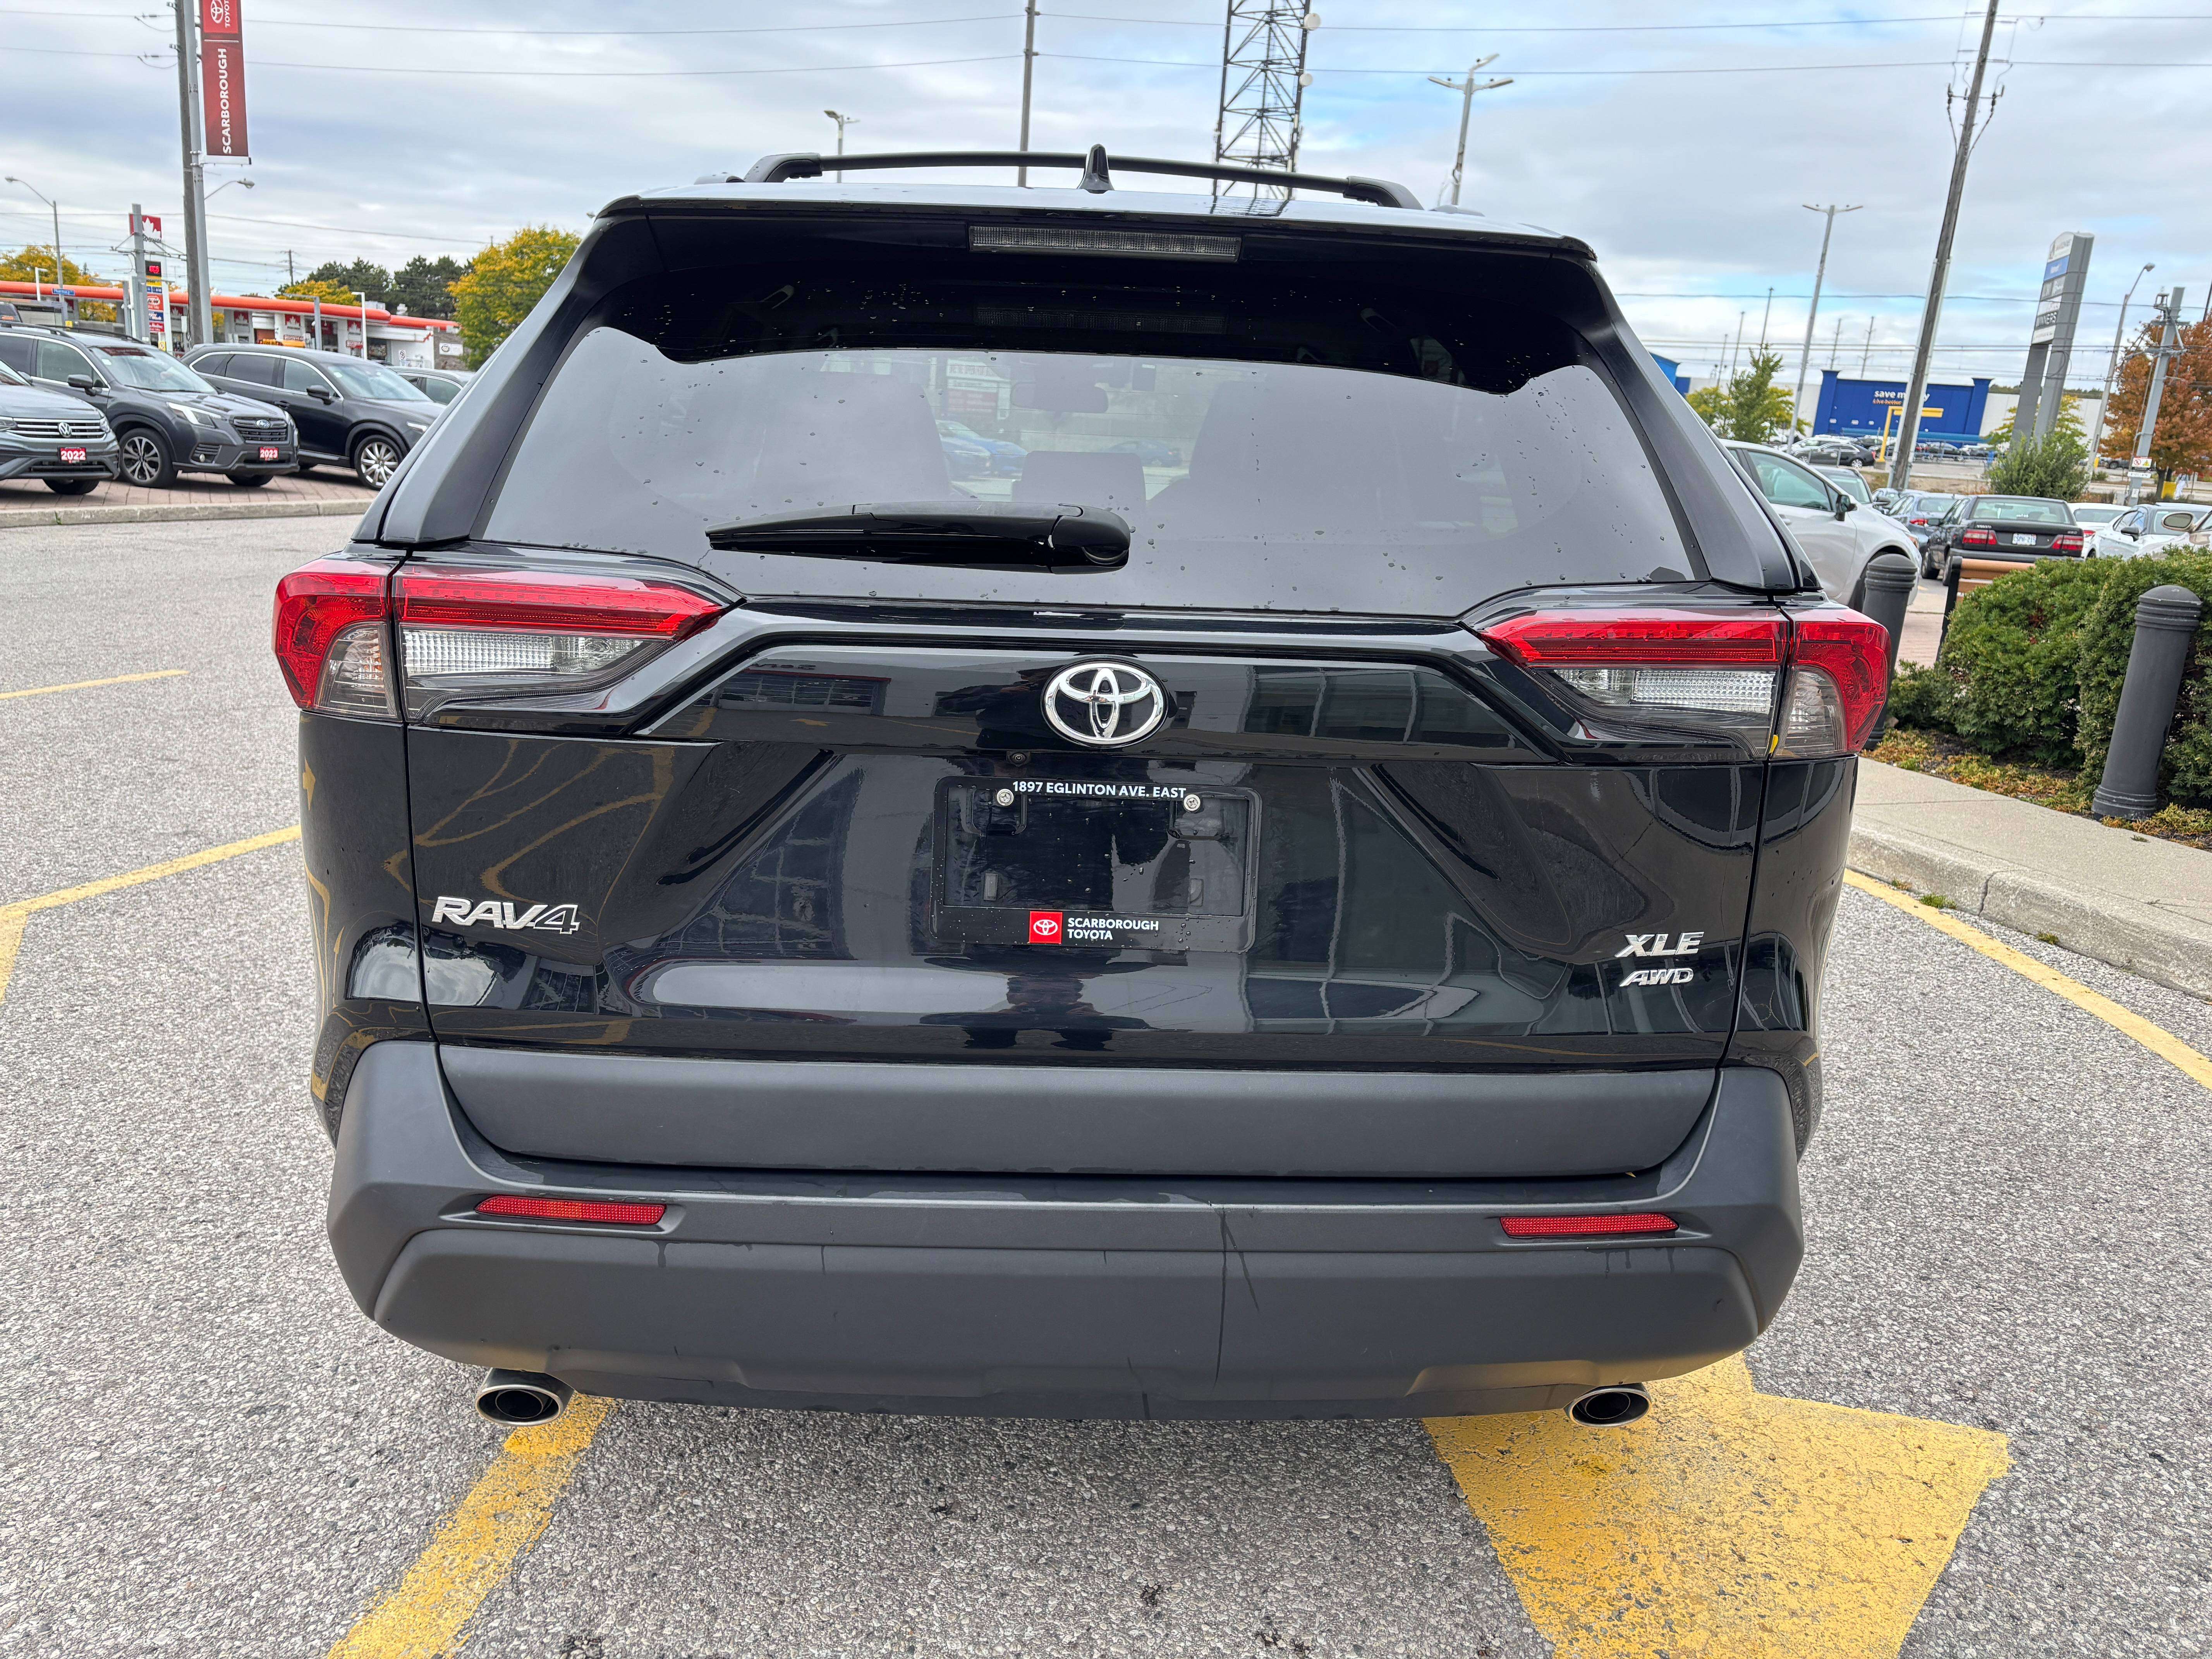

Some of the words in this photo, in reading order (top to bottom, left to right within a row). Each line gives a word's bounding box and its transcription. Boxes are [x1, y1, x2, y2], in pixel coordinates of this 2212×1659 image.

[218, 48, 232, 154] SCARBOROUGH
[61, 450, 86, 460] 2022
[260, 449, 278, 458] 2023
[1013, 781, 1043, 792] 1897
[1047, 783, 1116, 795] EGLINTON
[1119, 785, 1149, 797] AVE.
[1153, 787, 1187, 798] EAST
[432, 896, 580, 934] RAV4
[1068, 917, 1159, 931] SCARBOROUGH
[1067, 929, 1113, 941] TOYOTA
[1614, 931, 1704, 957] XLE
[1619, 968, 1694, 987] AWD
